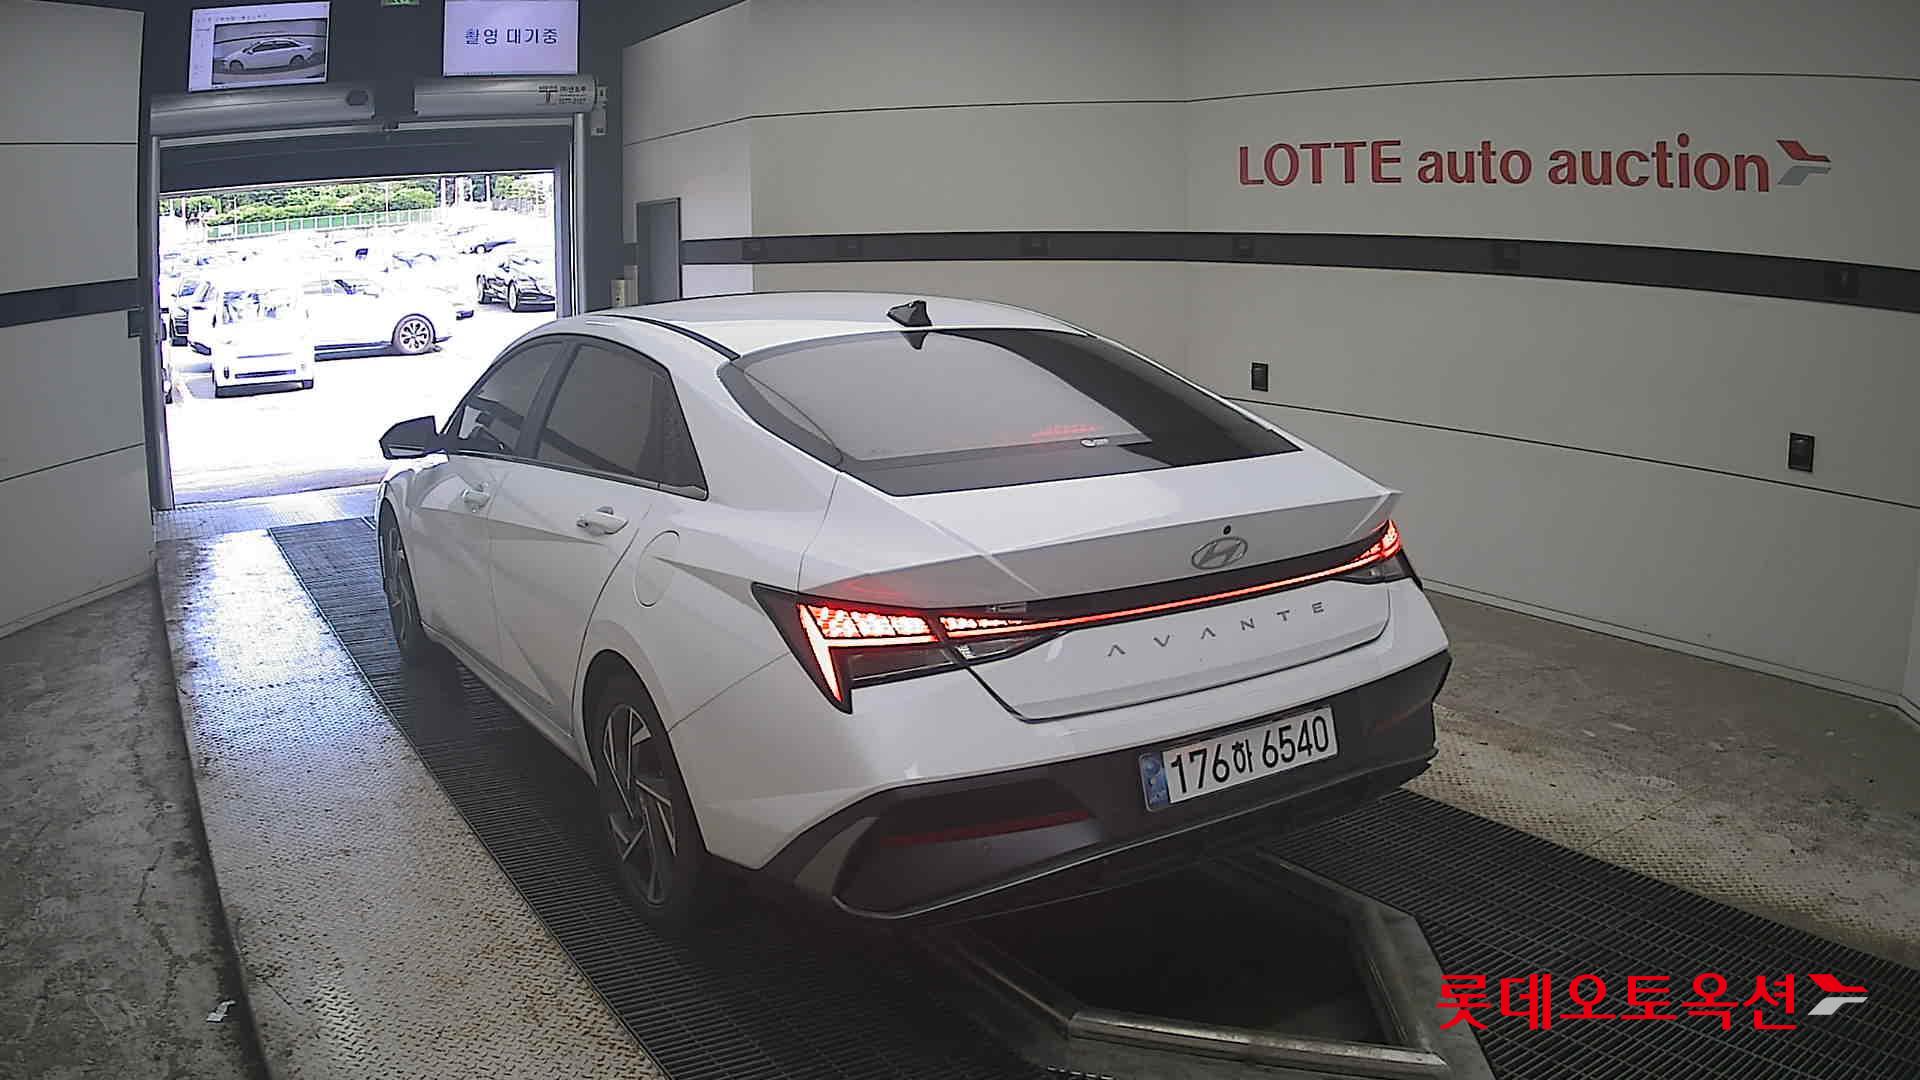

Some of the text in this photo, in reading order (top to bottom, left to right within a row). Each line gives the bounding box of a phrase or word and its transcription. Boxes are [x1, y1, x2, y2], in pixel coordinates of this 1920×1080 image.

[506, 27, 558, 45] 대기중
[1239, 132, 1770, 192] LOTTE auto auction
[1107, 601, 1325, 658] AVANTE
[1171, 715, 1329, 793] 176하 6540
